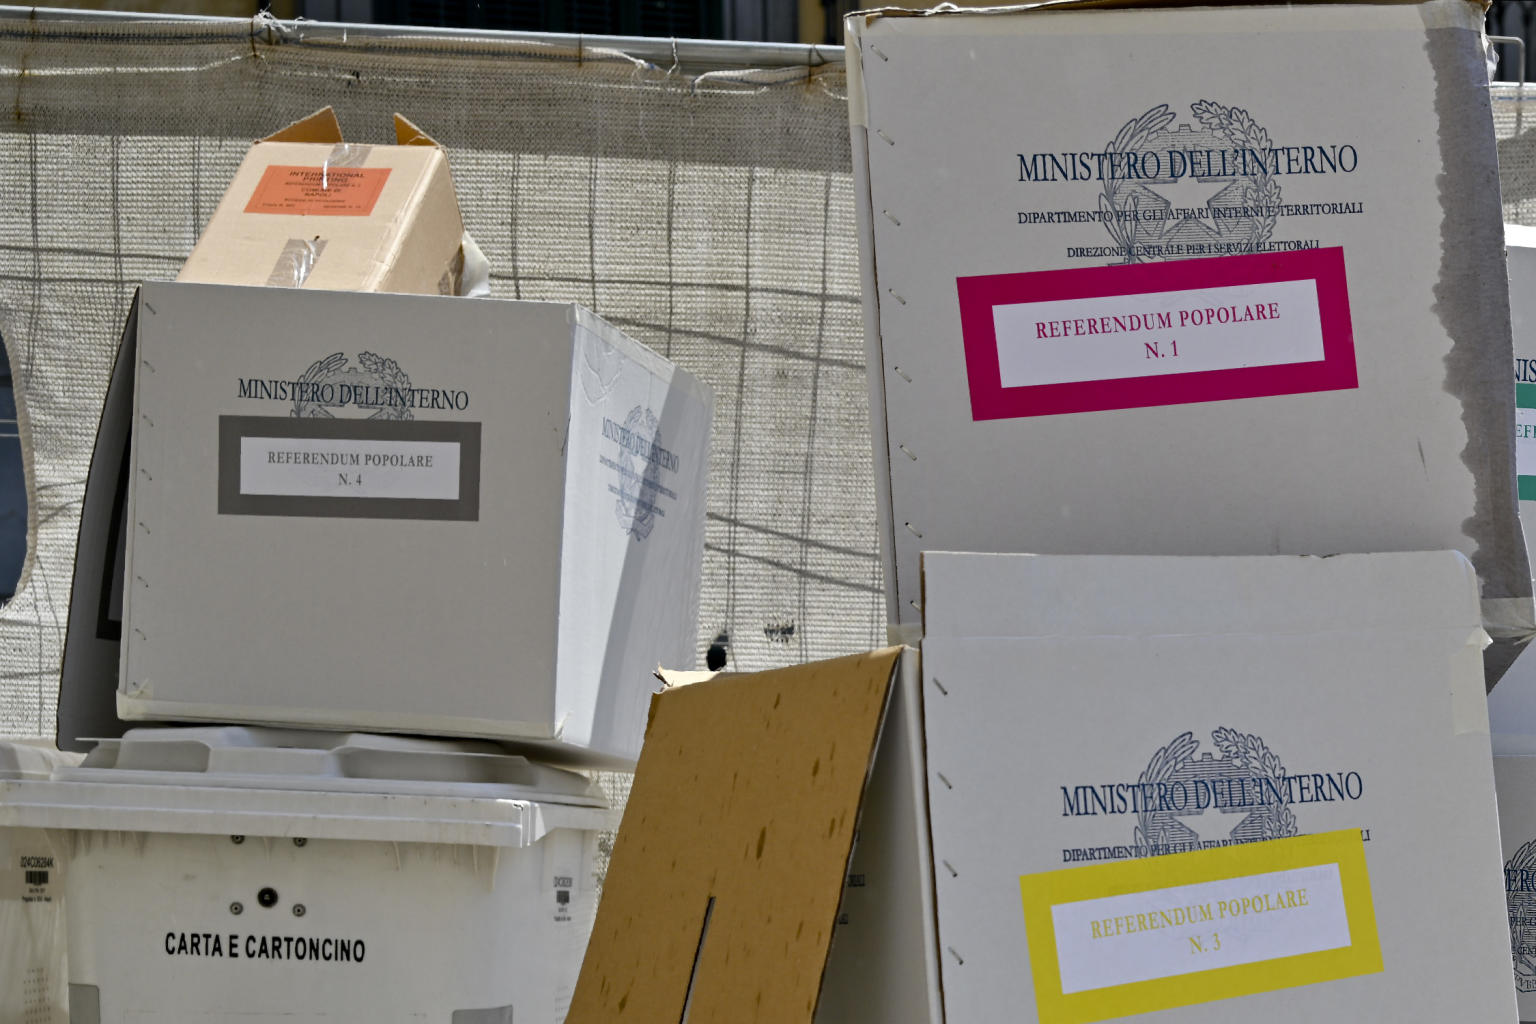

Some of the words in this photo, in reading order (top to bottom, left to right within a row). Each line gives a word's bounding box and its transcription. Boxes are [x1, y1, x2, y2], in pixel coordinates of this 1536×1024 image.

[1017, 150, 1161, 183] MINISTERO
[1167, 144, 1359, 179] DELL'INTERNO
[1017, 210, 1113, 224] DIPARTIMENTO
[1116, 208, 1141, 223] PER
[1143, 208, 1167, 222] GLI
[1167, 206, 1209, 221] AFFARI
[1212, 205, 1264, 220] INTERNI
[1265, 205, 1277, 217] E
[1278, 202, 1364, 217] TERRITORIALI
[1067, 245, 1128, 258] DIREZIONE
[1128, 243, 1183, 257] CENTRALE
[1185, 242, 1205, 255] PER
[1213, 241, 1255, 254] SERVIZI
[1256, 239, 1319, 253] ELETTORALI
[1035, 311, 1172, 339] REFERENDUM
[1179, 302, 1281, 328] POPOLARE
[1144, 341, 1165, 359] N.
[1171, 339, 1179, 357] 1
[237, 378, 335, 404] MINISTERO
[339, 384, 469, 410] DELL'INTERNO
[267, 451, 360, 466] REFERENDUM
[364, 453, 433, 468] POPOLARE
[338, 473, 352, 486] N.
[356, 474, 362, 486] 4
[1061, 781, 1188, 816] MINISTERO
[1193, 771, 1363, 810] DELL'INTERNO
[1063, 844, 1148, 862] DIPARTIMENTO
[1090, 905, 1214, 939] REFERENDUM
[1218, 888, 1309, 920] POPOLARE
[165, 932, 223, 957] CARTA
[229, 934, 239, 958] E
[245, 935, 366, 963] CARTONCINO
[1188, 935, 1208, 955] N.
[1213, 933, 1222, 950] 3
